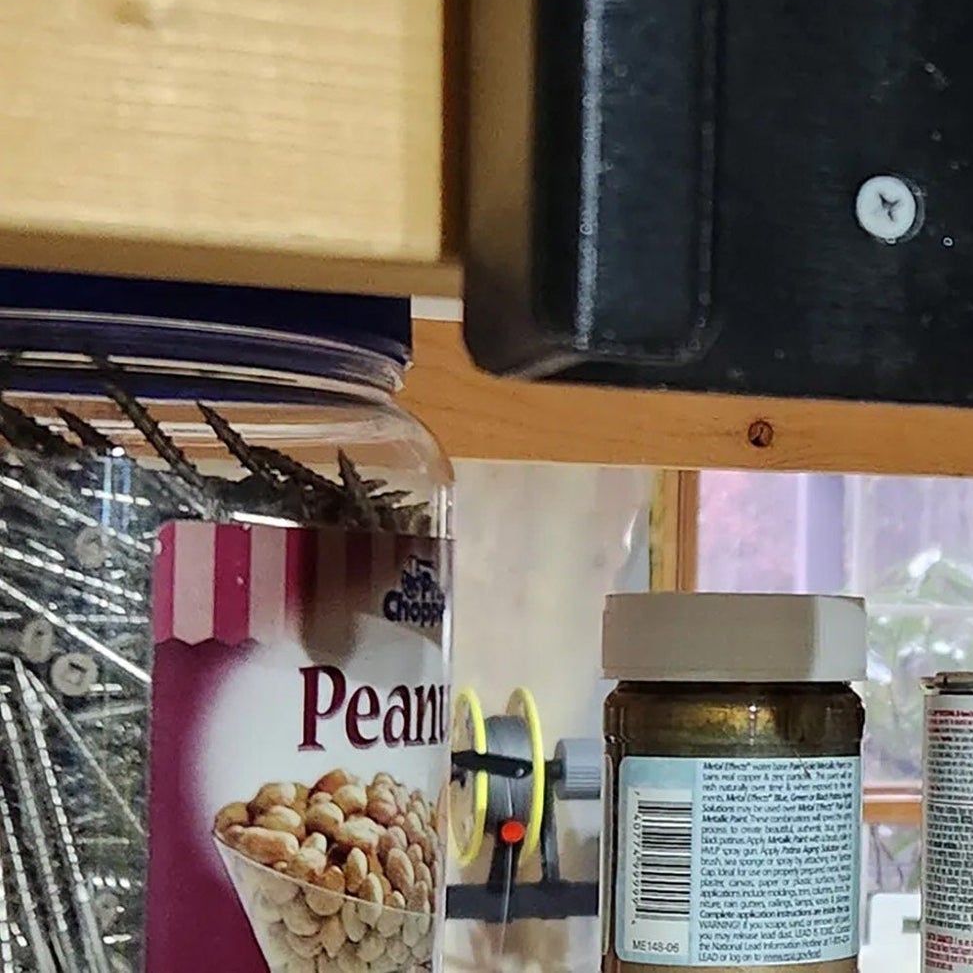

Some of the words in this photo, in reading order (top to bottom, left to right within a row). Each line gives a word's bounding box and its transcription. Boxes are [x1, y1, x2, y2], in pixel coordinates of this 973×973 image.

[722, 773, 735, 781] real
[737, 775, 761, 783] copper
[719, 784, 748, 793] naturally
[726, 794, 746, 802] Metal
[702, 804, 735, 812] Solutions
[737, 806, 751, 814] may
[702, 814, 727, 822] Metallic
[750, 815, 767, 823] These
[747, 836, 766, 846] Apply
[722, 848, 741, 857] spray
[761, 846, 779, 856] Apply
[701, 857, 722, 866] brush,
[739, 858, 764, 868] sponge
[776, 857, 793, 867] spray
[718, 868, 734, 876] Ideal
[737, 868, 747, 876] for
[773, 867, 799, 877] properly
[758, 879, 779, 888] paper
[700, 889, 740, 898] applications
[742, 889, 766, 897] include
[699, 910, 735, 919] Complete
[737, 909, 776, 919] application
[777, 907, 812, 916] instructions
[750, 922, 762, 930] you
[699, 933, 712, 941] you
[714, 933, 730, 941] may
[761, 931, 777, 939] lead
[795, 929, 812, 937] LEAD
[699, 942, 710, 950] the
[712, 941, 742, 950] National
[744, 941, 762, 950] Lead
[764, 939, 800, 949] Information
[698, 952, 719, 961] LEAD
[729, 952, 741, 963] log
